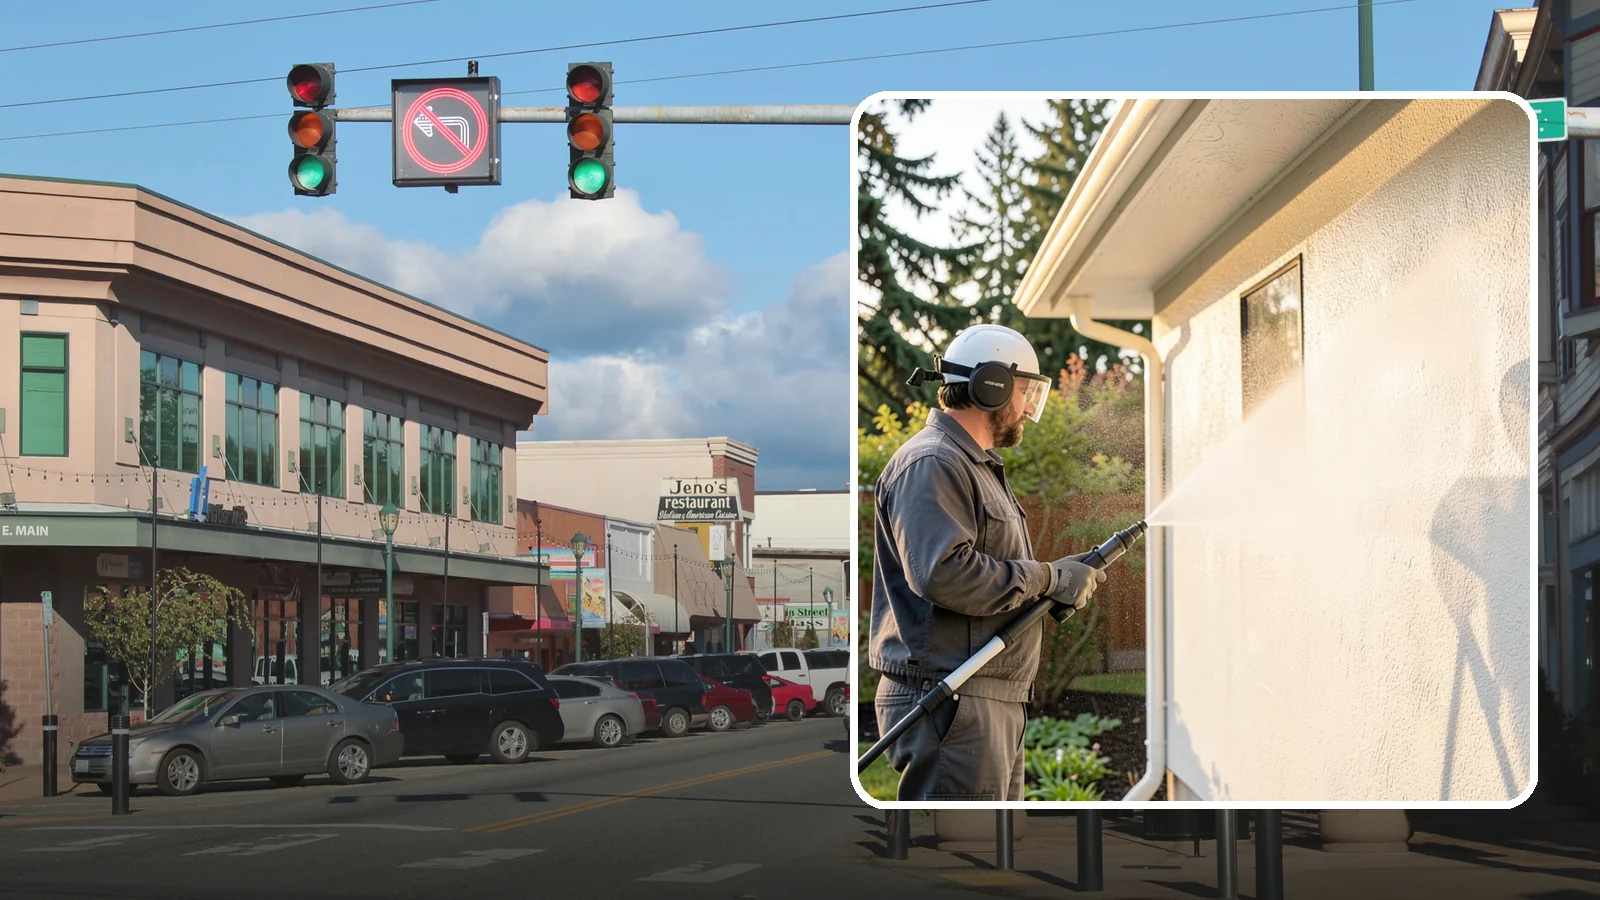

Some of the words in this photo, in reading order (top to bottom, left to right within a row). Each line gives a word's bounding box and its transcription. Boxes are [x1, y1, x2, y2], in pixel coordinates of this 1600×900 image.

[670, 480, 727, 494] Jeno's
[665, 496, 731, 509] restaurant
[686, 510, 714, 519] American
[715, 510, 738, 519] Cuisine
[2, 525, 13, 536] E.
[15, 525, 49, 536] MAIN
[797, 607, 828, 617] Street
[791, 619, 824, 627] lass
